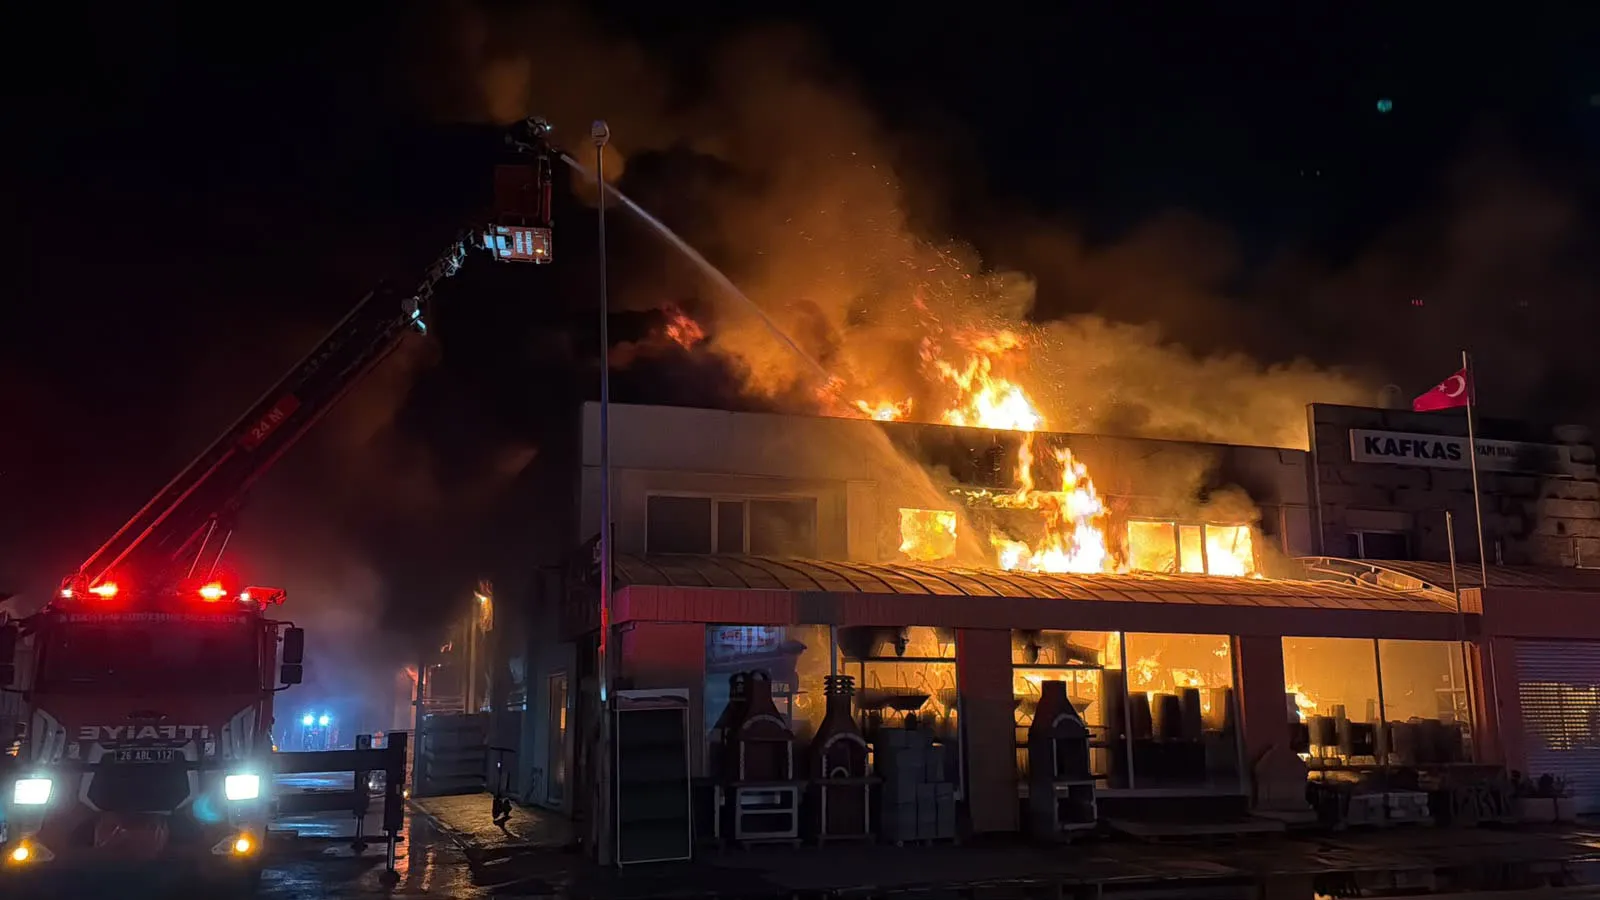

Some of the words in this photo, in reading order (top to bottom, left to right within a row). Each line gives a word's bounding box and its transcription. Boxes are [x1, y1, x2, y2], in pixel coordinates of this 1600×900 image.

[251, 420, 270, 439] 24
[1364, 436, 1461, 460] KAFKAS
[120, 751, 131, 761] 26
